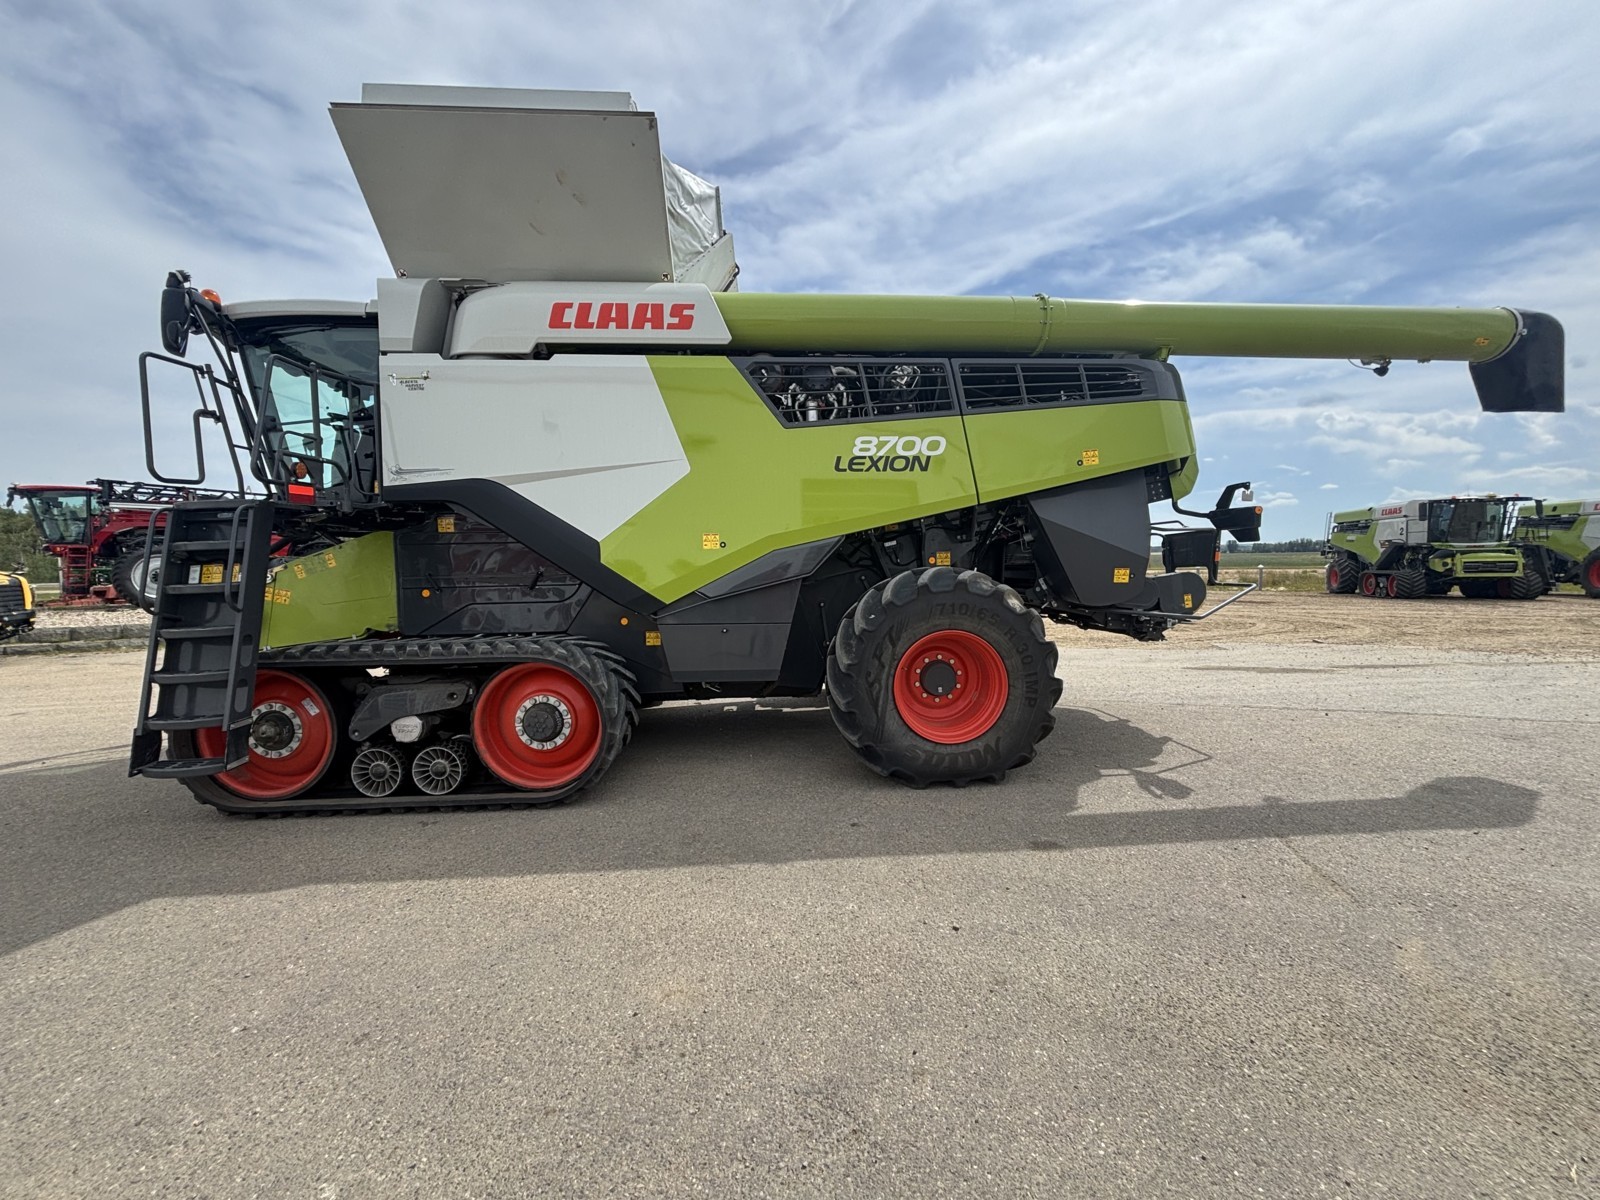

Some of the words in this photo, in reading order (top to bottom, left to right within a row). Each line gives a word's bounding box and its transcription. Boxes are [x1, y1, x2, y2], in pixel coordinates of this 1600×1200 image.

[548, 302, 695, 330] CLAAS
[852, 435, 947, 456] 8700
[834, 455, 932, 472] LEXION
[1381, 507, 1403, 516] CLAAS
[1399, 527, 1404, 535] 2
[1016, 642, 1034, 665] 30
